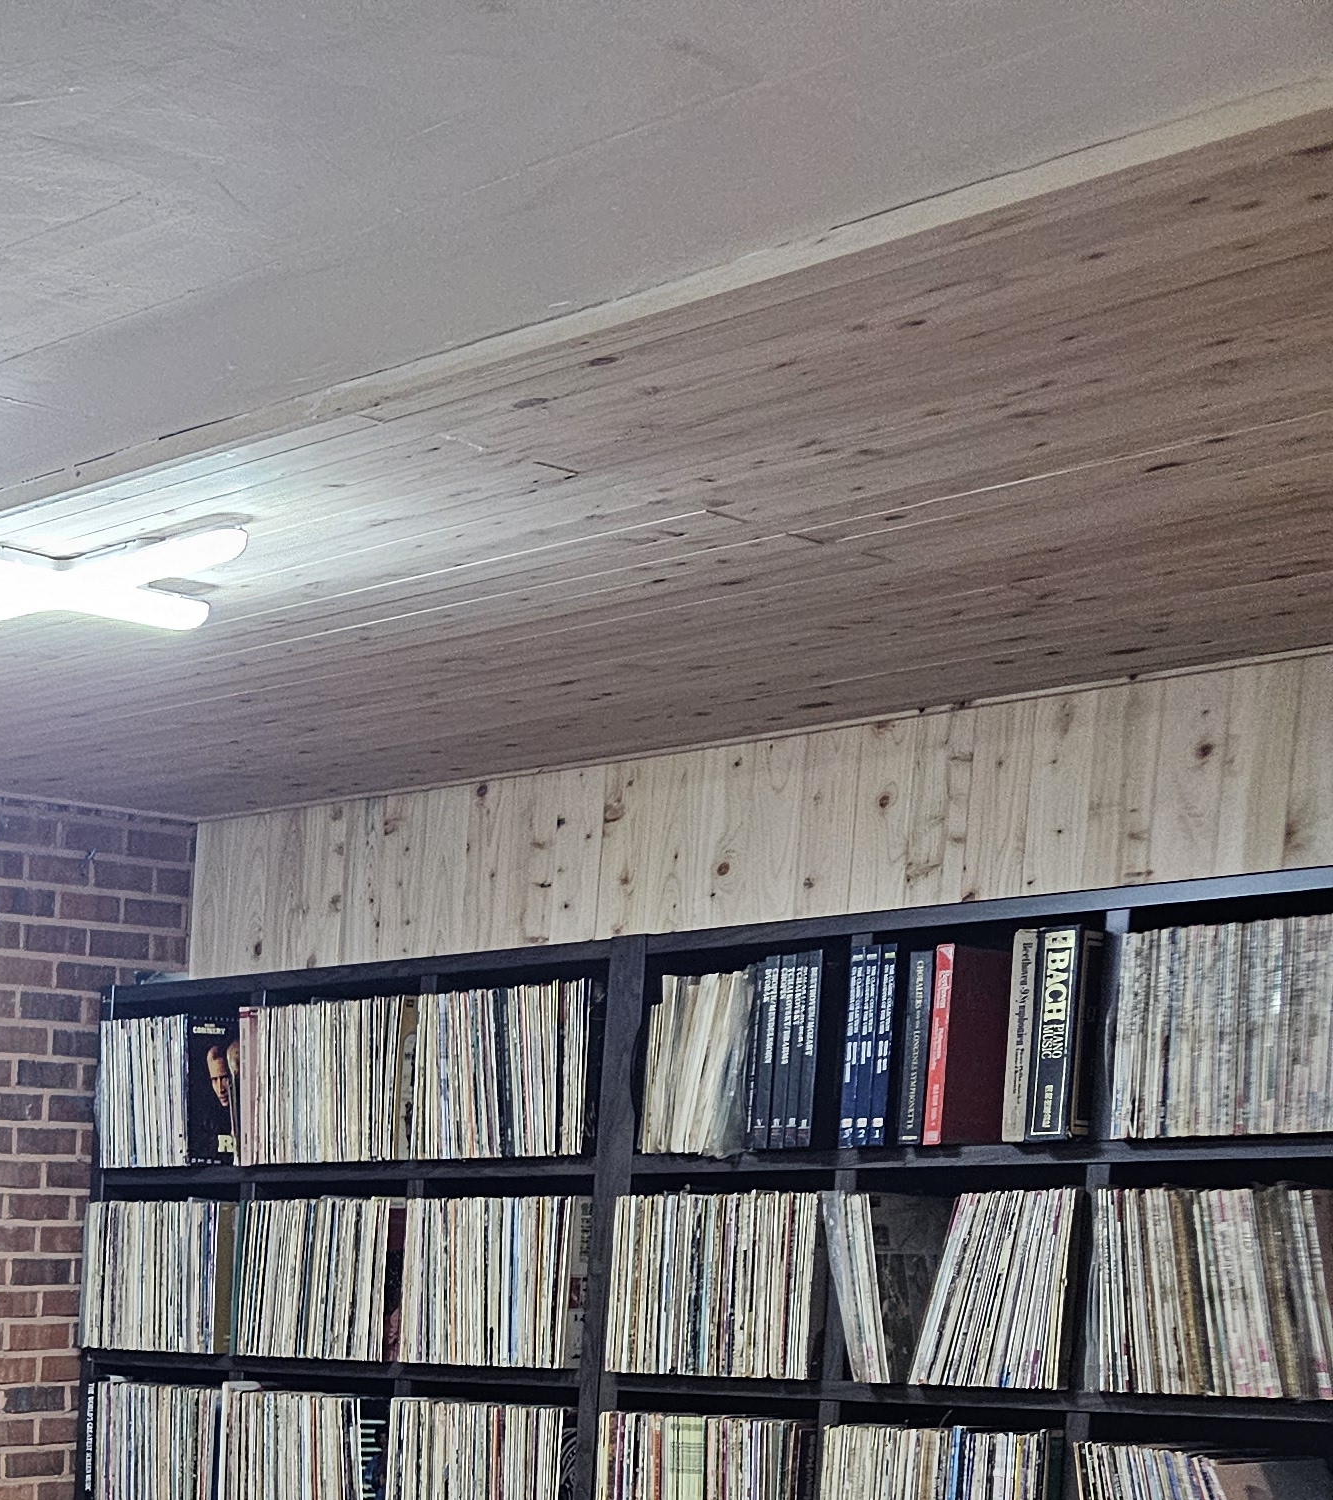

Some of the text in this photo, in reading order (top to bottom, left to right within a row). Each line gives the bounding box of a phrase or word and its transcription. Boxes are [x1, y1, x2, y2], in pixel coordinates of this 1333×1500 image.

[1043, 949, 1071, 1059] BACH PIANO
[1041, 1024, 1054, 1060] MUSIC
